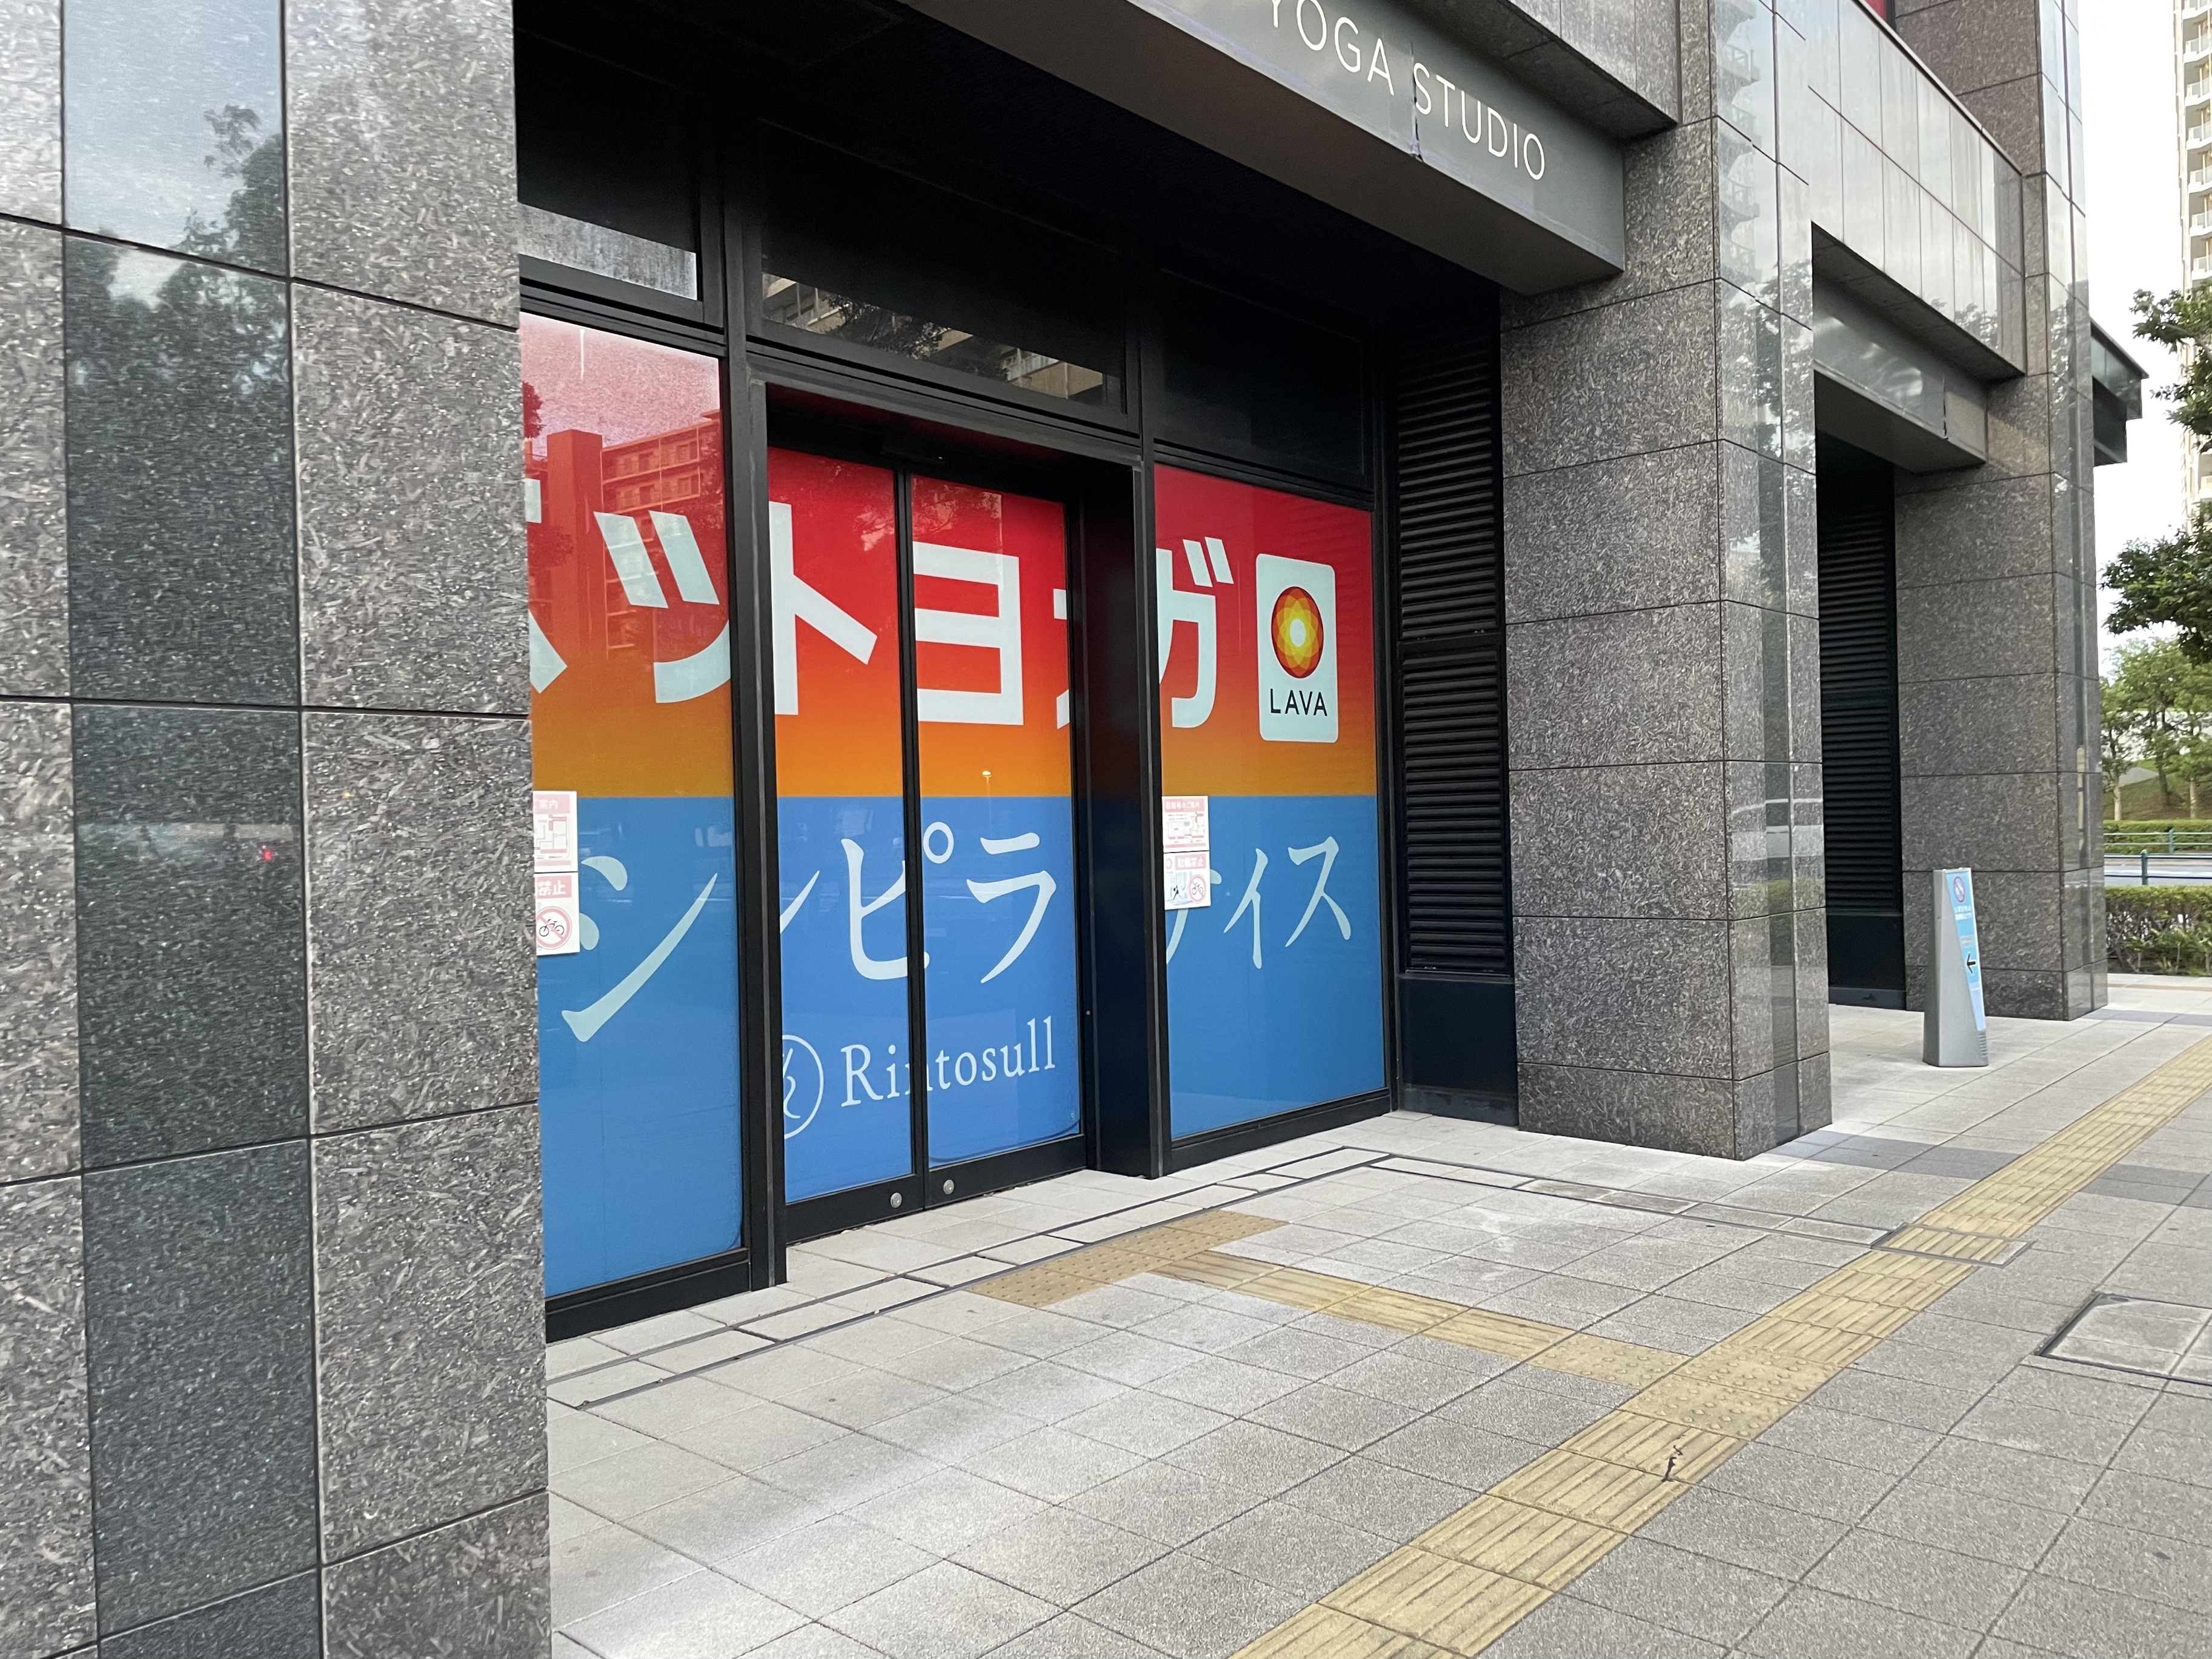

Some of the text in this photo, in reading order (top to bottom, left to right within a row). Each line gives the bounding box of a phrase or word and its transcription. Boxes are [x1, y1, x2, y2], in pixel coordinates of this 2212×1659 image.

[1413, 62, 1545, 180] STUDIO
[1269, 688, 1327, 717] LAVA
[537, 879, 566, 896] 禁止
